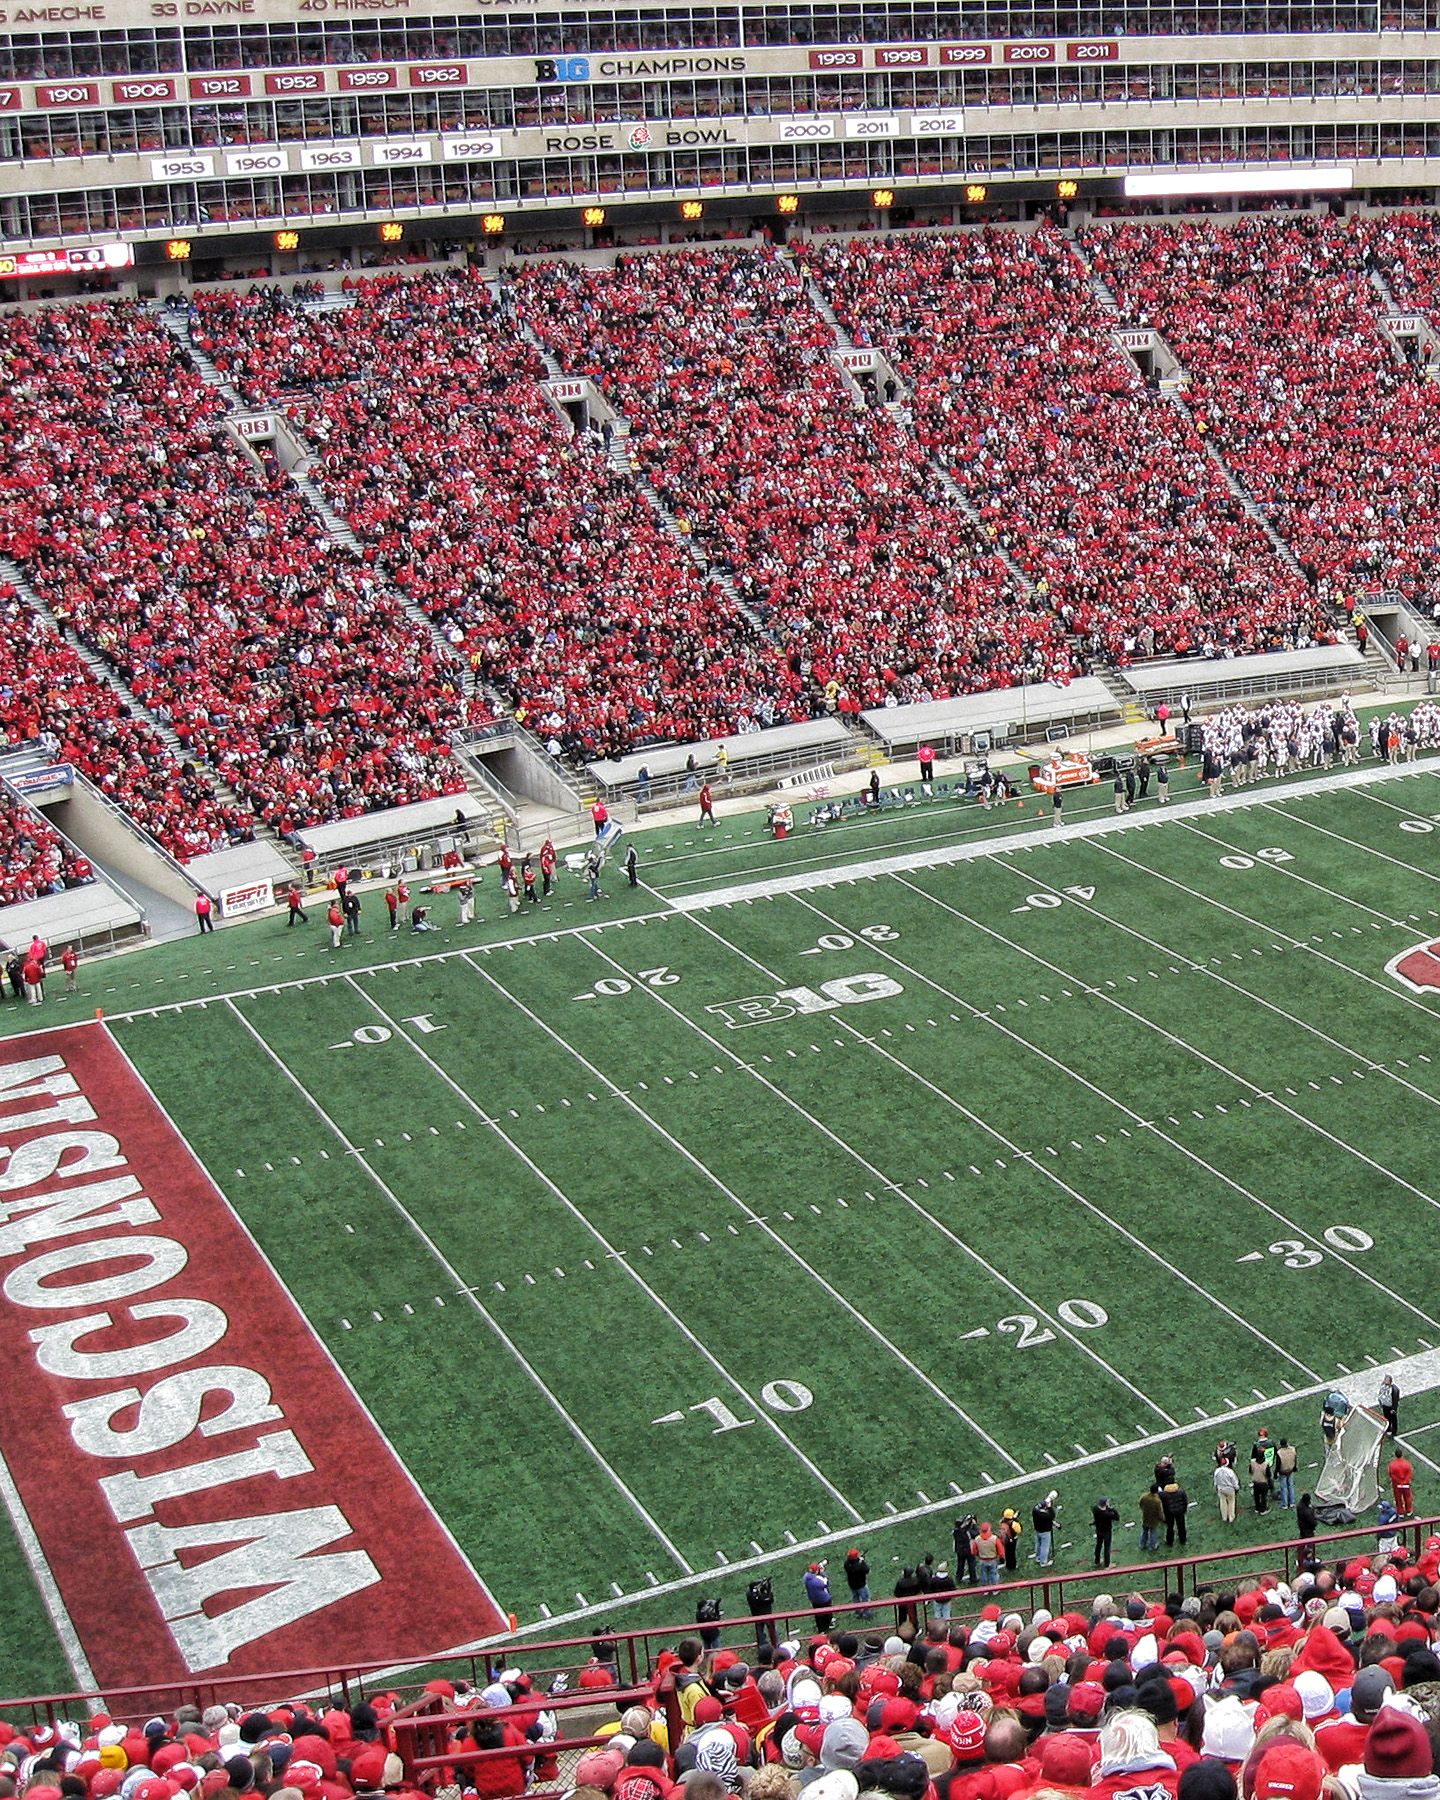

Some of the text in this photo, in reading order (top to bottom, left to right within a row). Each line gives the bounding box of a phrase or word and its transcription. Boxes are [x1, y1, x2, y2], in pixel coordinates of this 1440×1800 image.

[14, 6, 106, 22] AMECHE
[151, 0, 255, 17] 33 DAYNE
[883, 50, 922, 63] 1998
[947, 48, 986, 61] 1999
[1010, 46, 1049, 59] 2010
[1077, 44, 1109, 57] 2011
[600, 57, 746, 76] CHAMPIONS
[816, 53, 857, 65] 1993
[275, 75, 318, 89] 1952
[347, 71, 390, 86] 1959
[418, 68, 461, 83] 1962
[121, 83, 169, 98] 1906
[202, 80, 240, 94] 1912
[47, 88, 89, 103] 1901
[784, 123, 830, 137] 2000
[857, 121, 889, 134] 2011
[920, 118, 956, 132] 2012
[546, 129, 737, 152] ROSE BOWL
[383, 147, 422, 161] 1994
[452, 143, 493, 156] 1999
[236, 157, 280, 171] 1960
[311, 152, 352, 165] 1963
[162, 161, 205, 176] 1953
[257, 421, 265, 432] S
[1219, 847, 1296, 870] 50
[227, 884, 267, 905] ESPN
[1026, 885, 1097, 908] 40
[817, 924, 900, 950] 30
[594, 966, 682, 996] 20
[354, 1013, 448, 1044] 10
[1268, 1225, 1375, 1269] 30
[998, 1298, 1109, 1349] 20
[690, 1378, 814, 1434] 10
